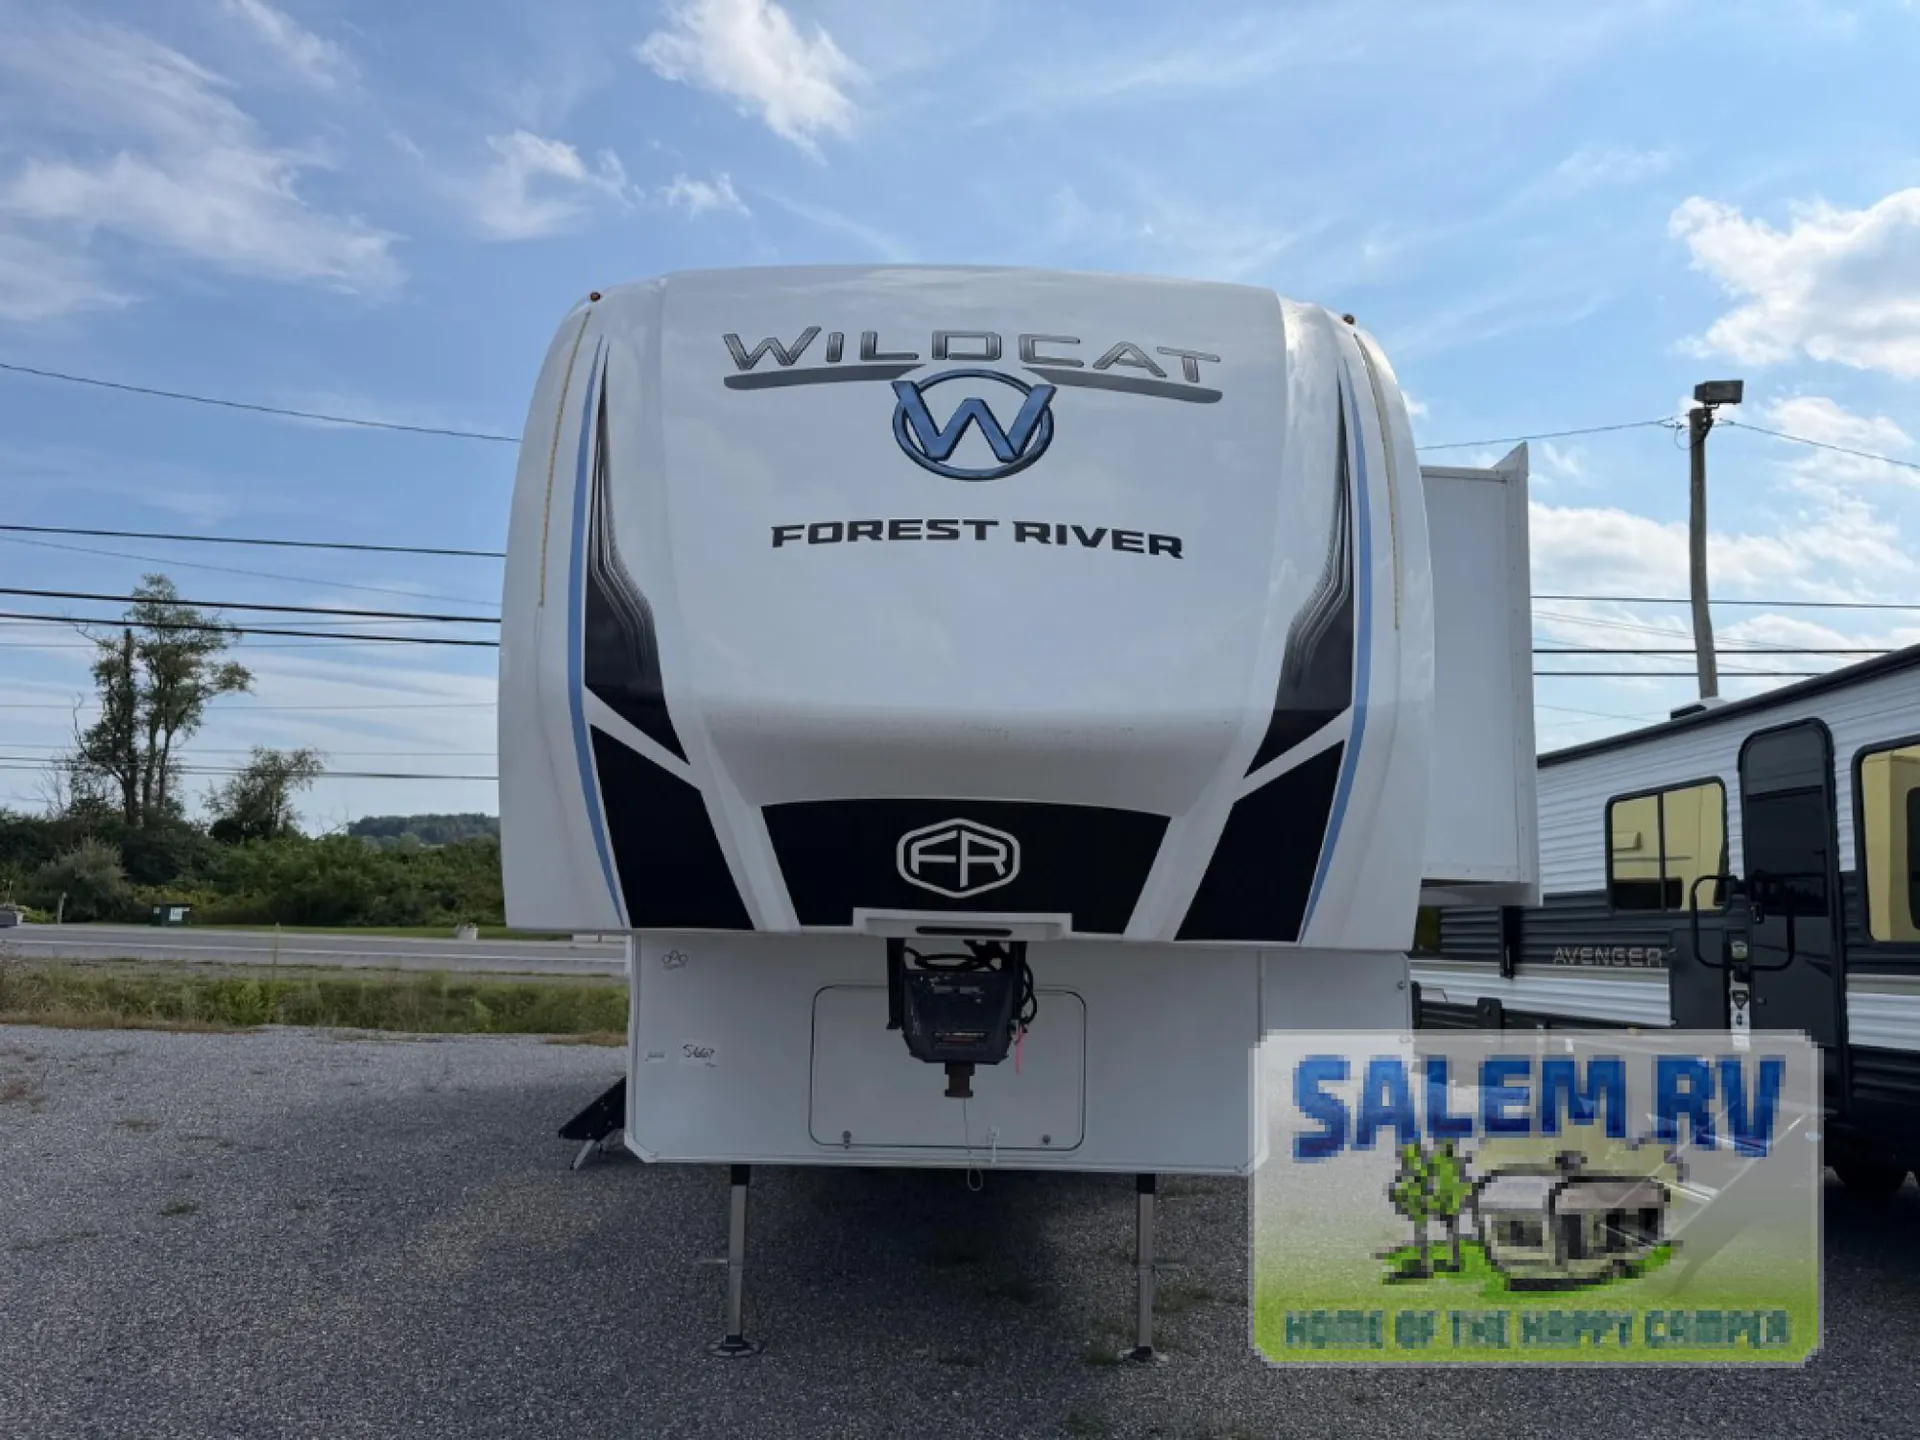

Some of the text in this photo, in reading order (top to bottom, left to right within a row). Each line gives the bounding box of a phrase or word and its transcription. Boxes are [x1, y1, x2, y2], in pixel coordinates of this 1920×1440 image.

[723, 326, 1220, 383] WILDCAT
[892, 379, 1057, 462] W
[772, 518, 1183, 559] FOREST RIVER
[1553, 946, 1663, 968] AVENGER
